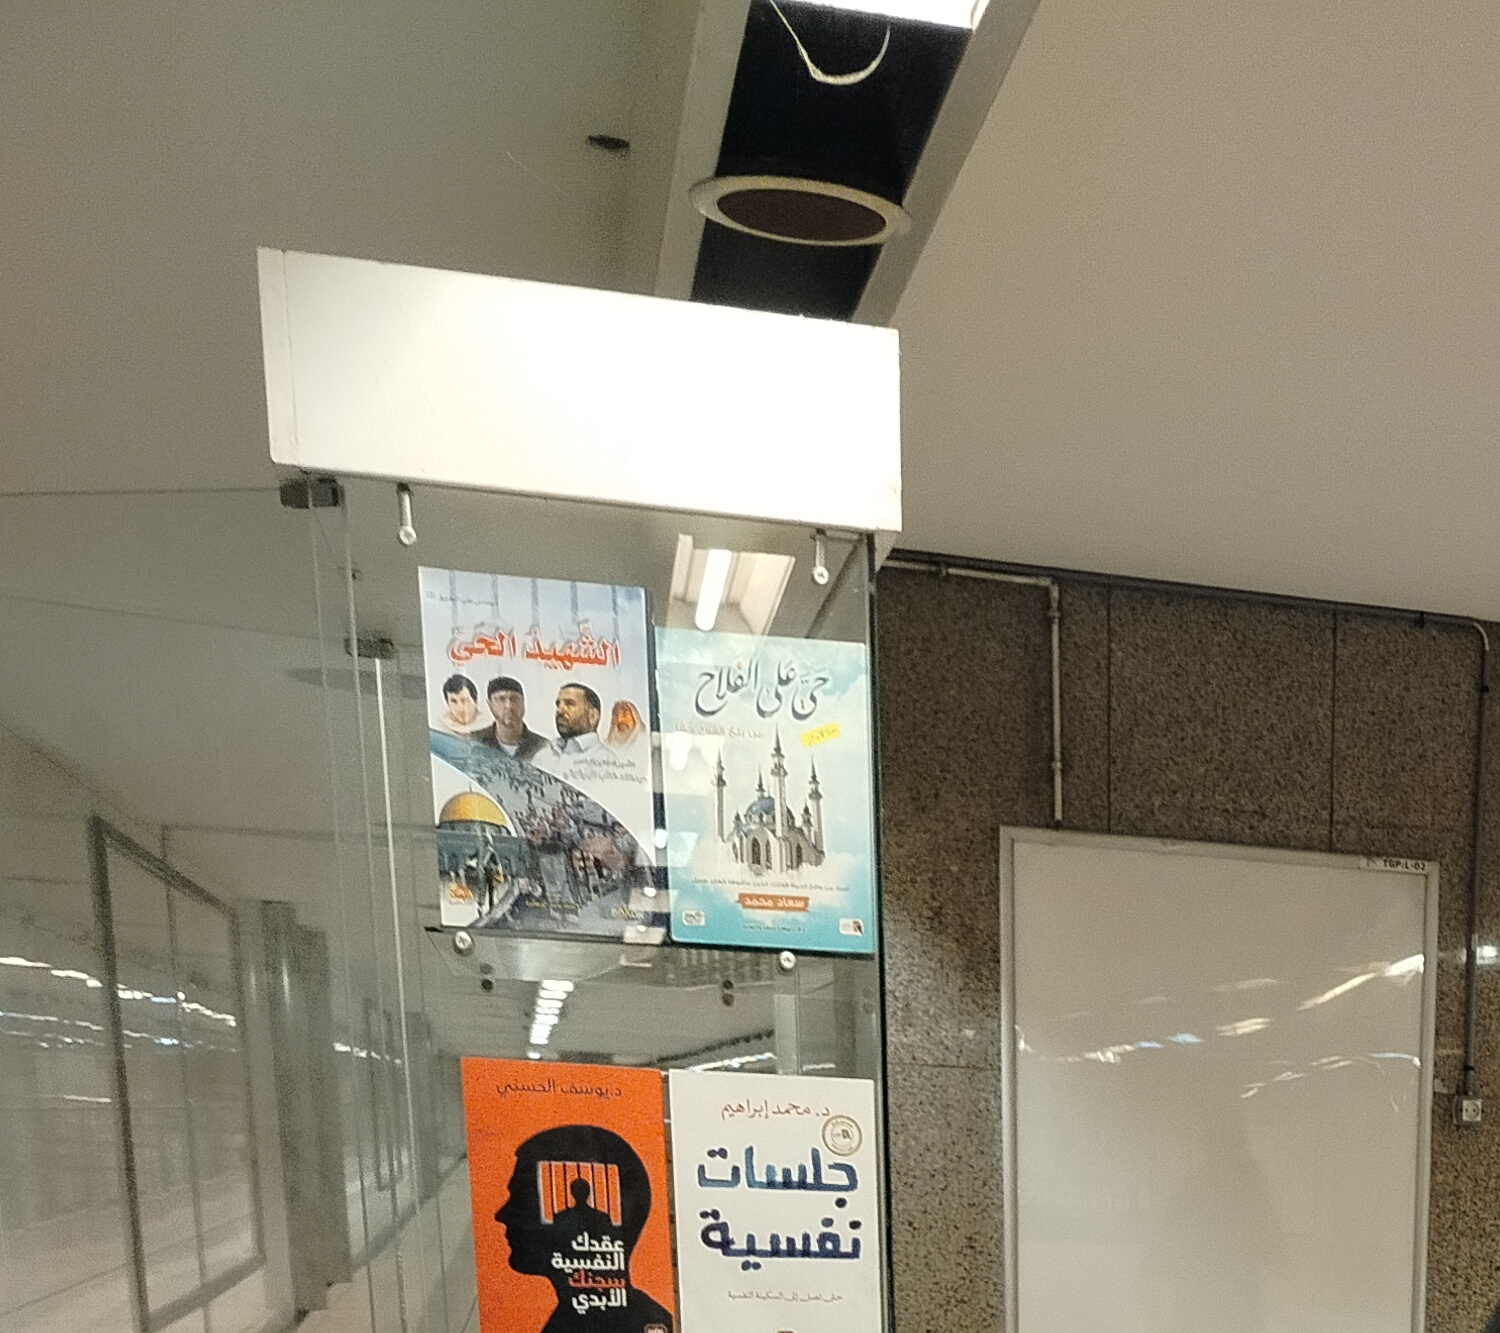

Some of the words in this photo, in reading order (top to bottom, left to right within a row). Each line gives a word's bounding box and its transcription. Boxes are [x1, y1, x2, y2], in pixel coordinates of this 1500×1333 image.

[721, 1099, 768, 1121] إبراهيم
[771, 1102, 811, 1116] محمد
[697, 1145, 859, 1208] جلسات
[571, 1231, 625, 1252] عقدك
[699, 1208, 862, 1272] نفسية
[551, 1251, 625, 1274] النفسية
[568, 1268, 626, 1293] سجنك
